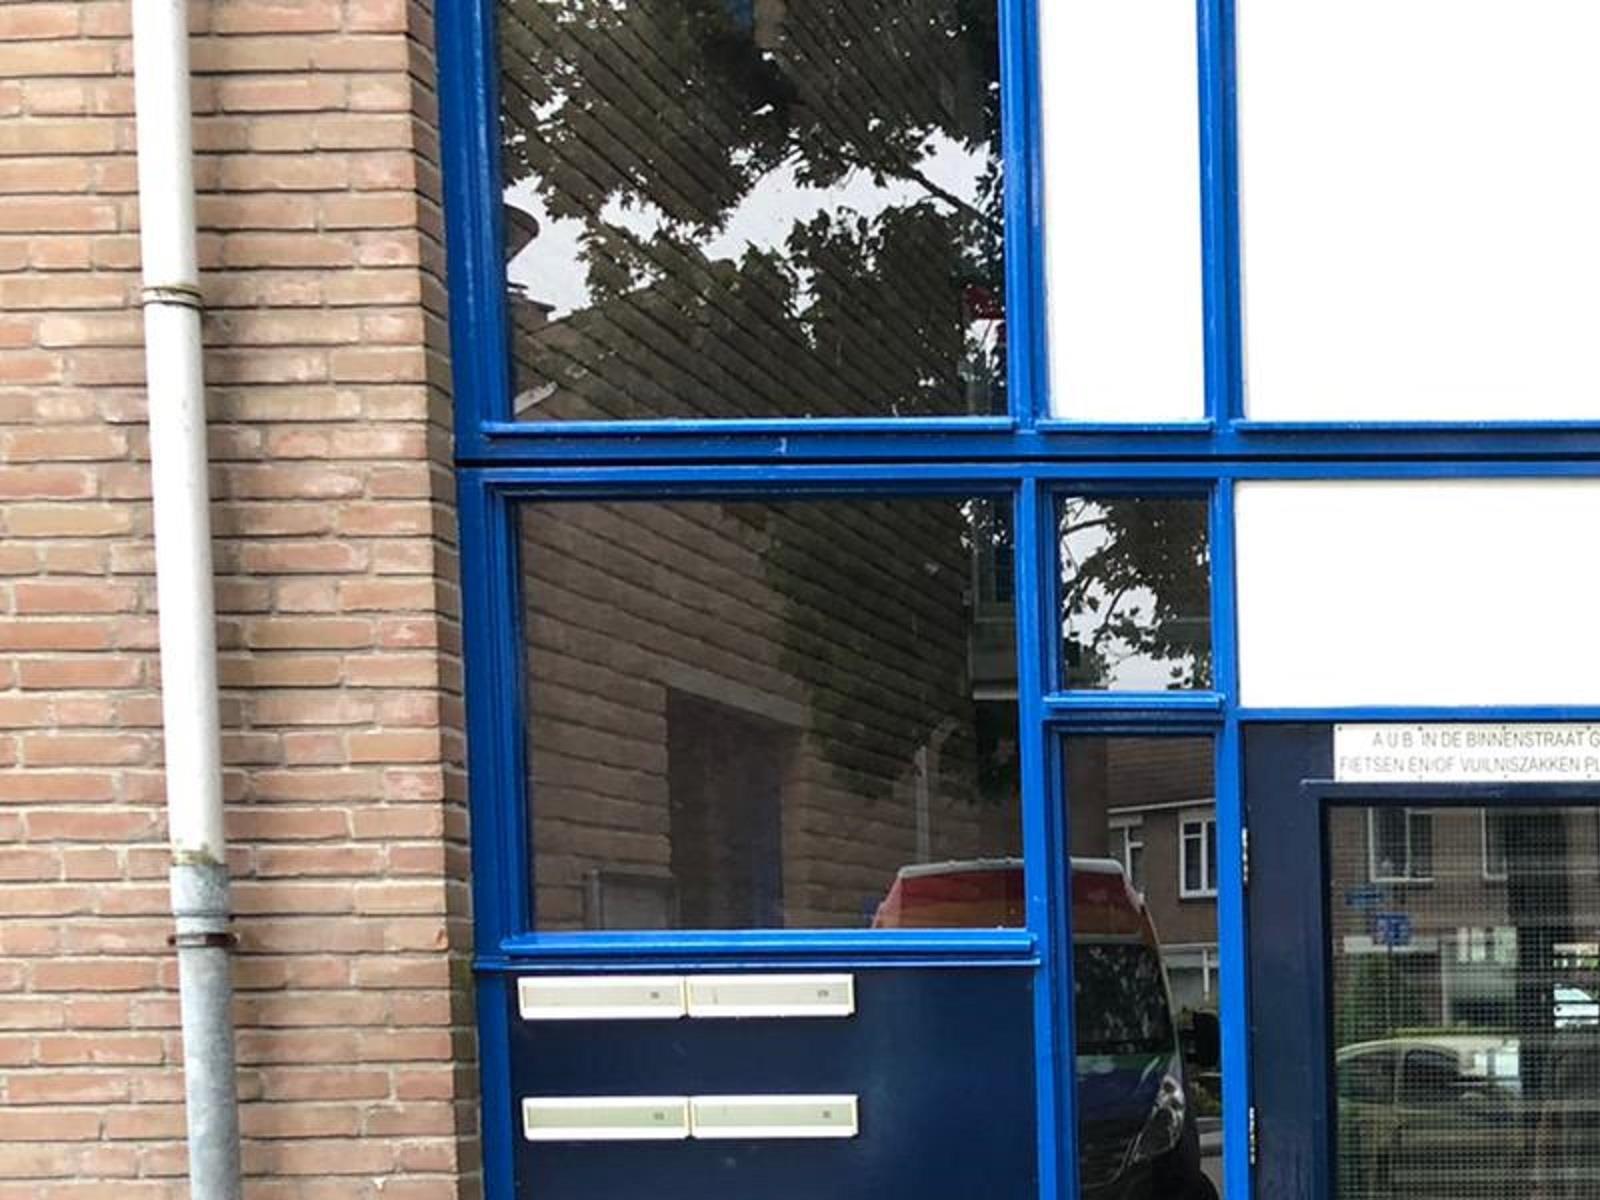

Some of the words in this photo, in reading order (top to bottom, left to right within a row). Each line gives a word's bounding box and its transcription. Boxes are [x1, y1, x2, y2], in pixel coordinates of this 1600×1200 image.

[1421, 731, 1438, 748] IN
[1441, 731, 1462, 748] DE
[1466, 730, 1584, 748] BINNENSTRAAT
[1339, 755, 1405, 773] FIETSEN
[1460, 755, 1580, 773] VUILNISZAKKEN
